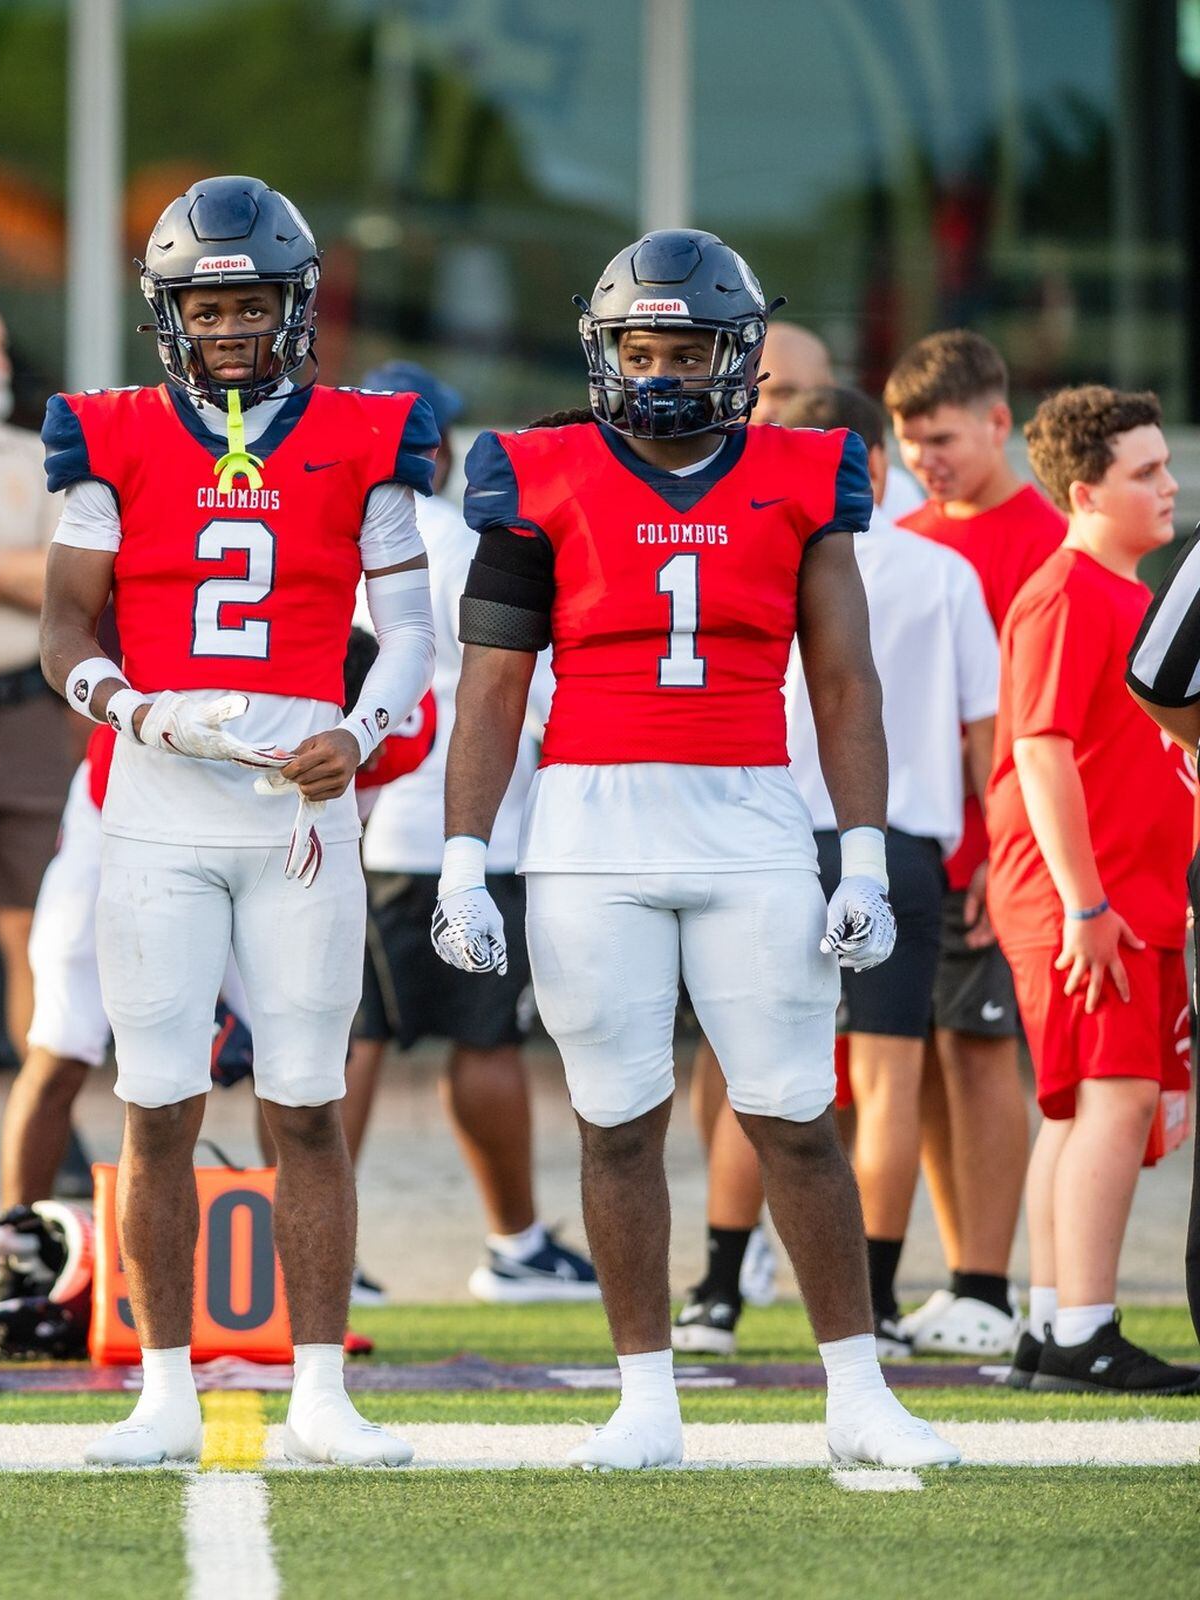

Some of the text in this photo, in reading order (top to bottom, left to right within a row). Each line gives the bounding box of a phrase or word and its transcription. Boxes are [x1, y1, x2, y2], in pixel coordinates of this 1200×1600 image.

[636, 301, 682, 312] Riddell
[197, 487, 280, 510] COLUMBUS
[637, 523, 729, 545] COLUMBUS
[190, 518, 277, 661] 2
[656, 552, 708, 689] 1
